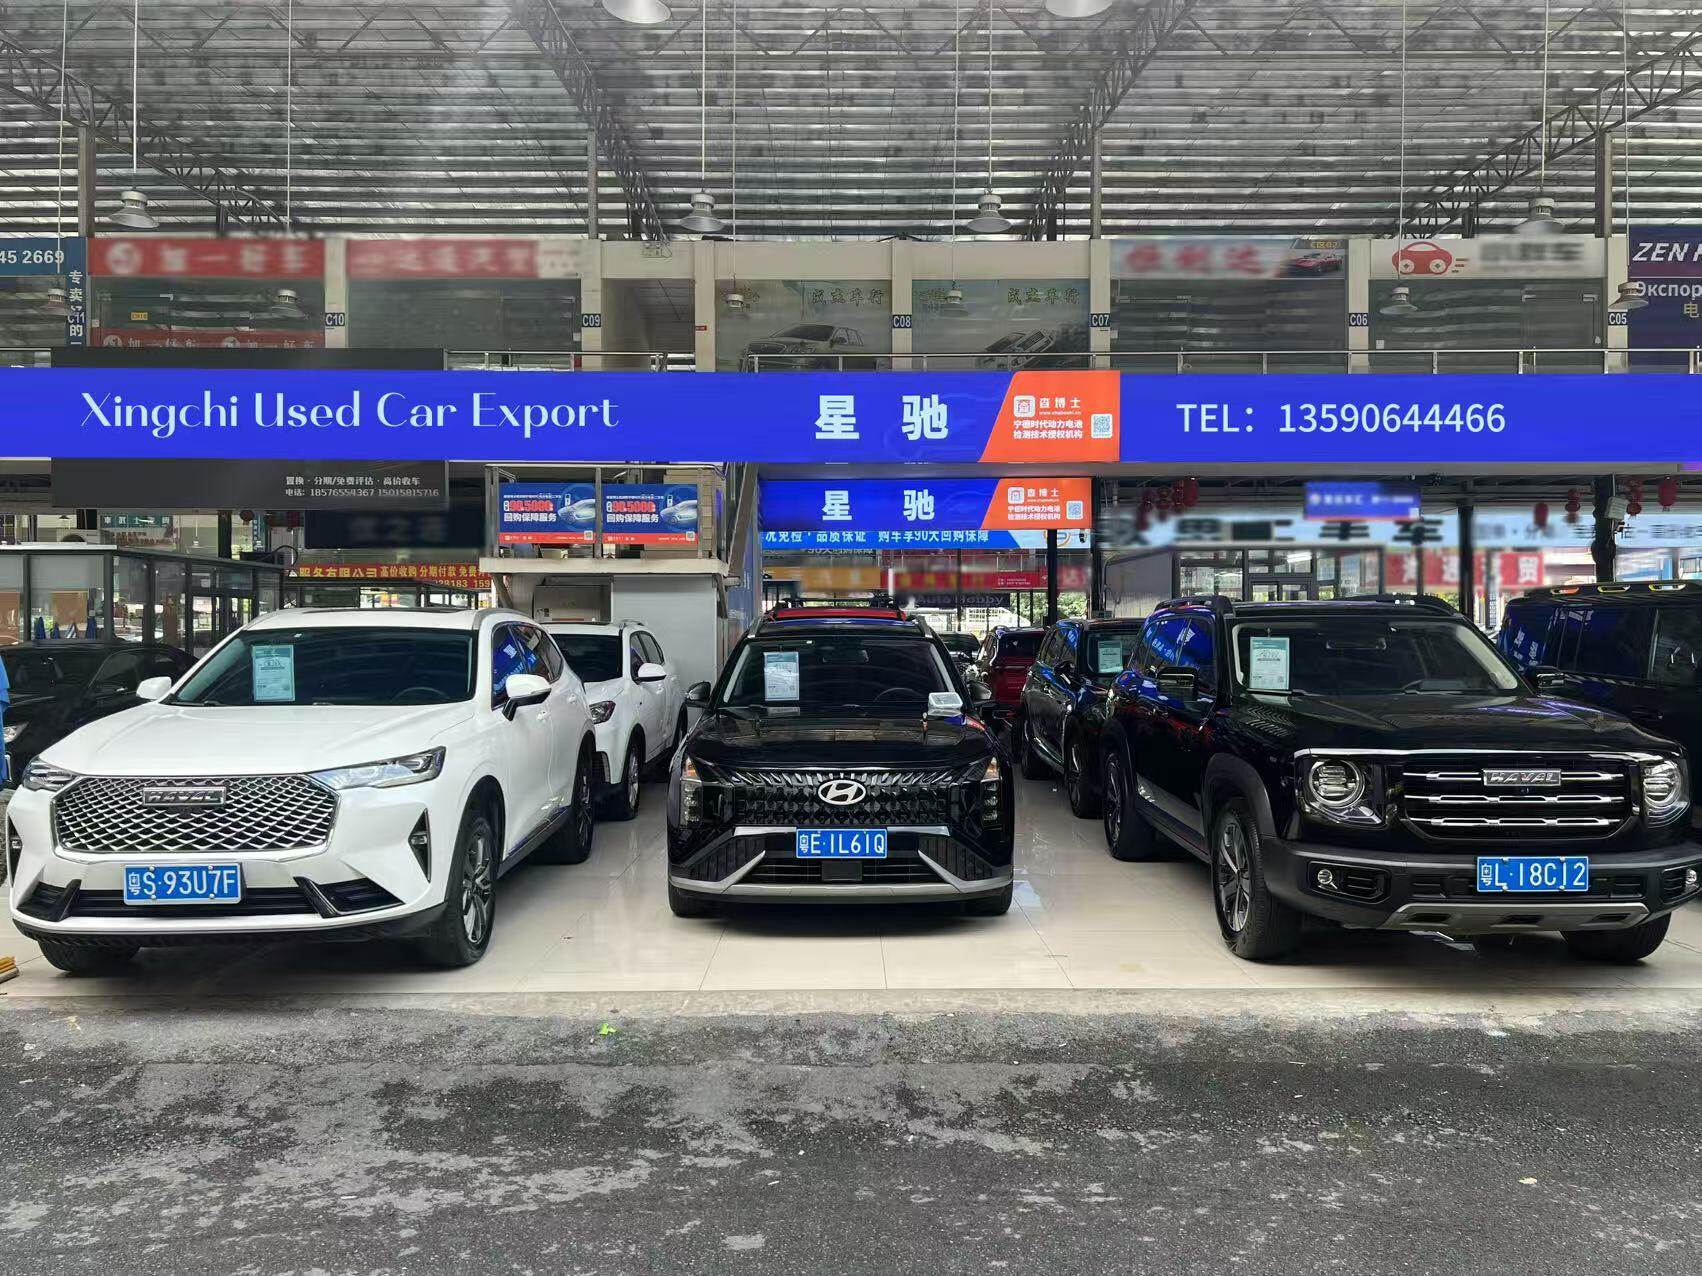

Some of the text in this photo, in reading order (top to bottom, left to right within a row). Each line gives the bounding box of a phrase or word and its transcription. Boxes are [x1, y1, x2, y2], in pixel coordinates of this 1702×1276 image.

[22, 250, 65, 264] 2669
[1632, 243, 1689, 262] ZEN
[67, 311, 85, 324] C11
[326, 314, 345, 326] C10
[582, 314, 600, 327] C09
[893, 315, 911, 328] C08
[1092, 314, 1110, 326] C07
[1350, 314, 1368, 326] C06
[1609, 313, 1627, 325] C05
[82, 391, 619, 438] Xingchi Used Car Export
[1279, 404, 1506, 433] 13590644466
[1013, 420, 1083, 429] 宁德时代动力电池
[1013, 430, 1083, 439] 检测技术授权机构
